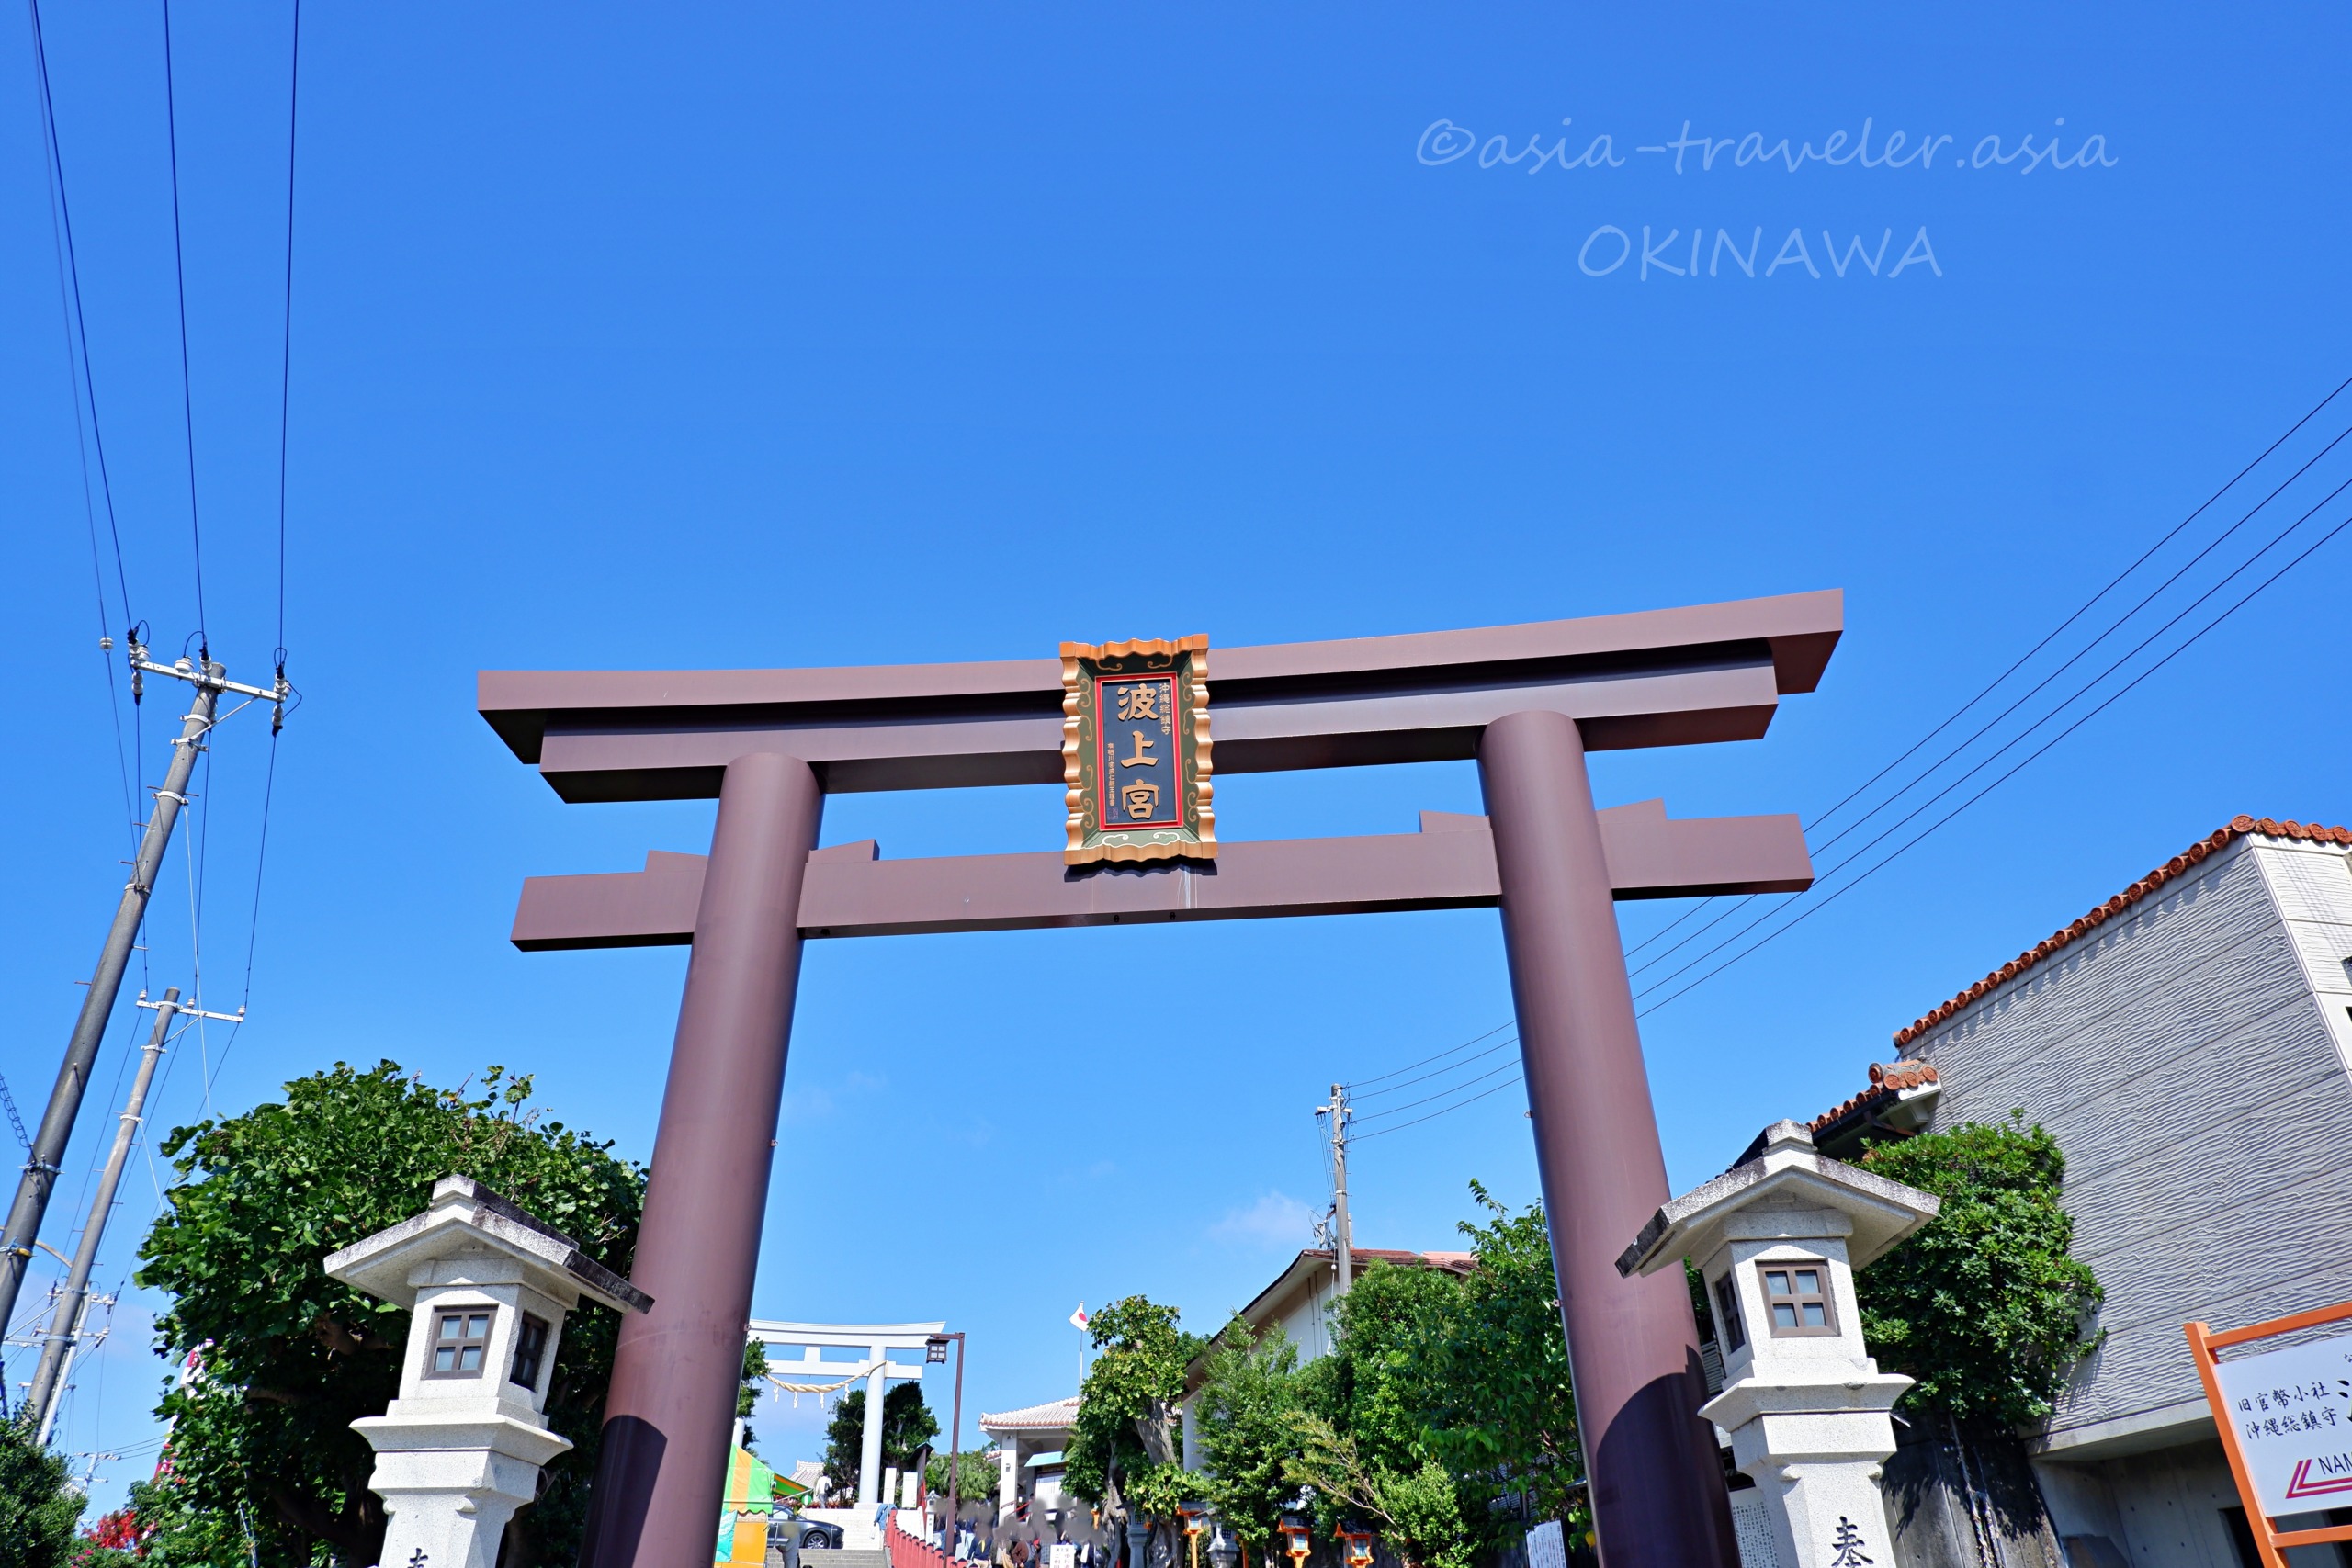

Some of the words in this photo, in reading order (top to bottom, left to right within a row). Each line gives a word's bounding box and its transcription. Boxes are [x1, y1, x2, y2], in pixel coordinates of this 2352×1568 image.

[1117, 683, 1159, 820] 波上宮
[2238, 1382, 2330, 1412] 旧官幣小社
[2245, 1406, 2336, 1440] 沖縄総鎮守
